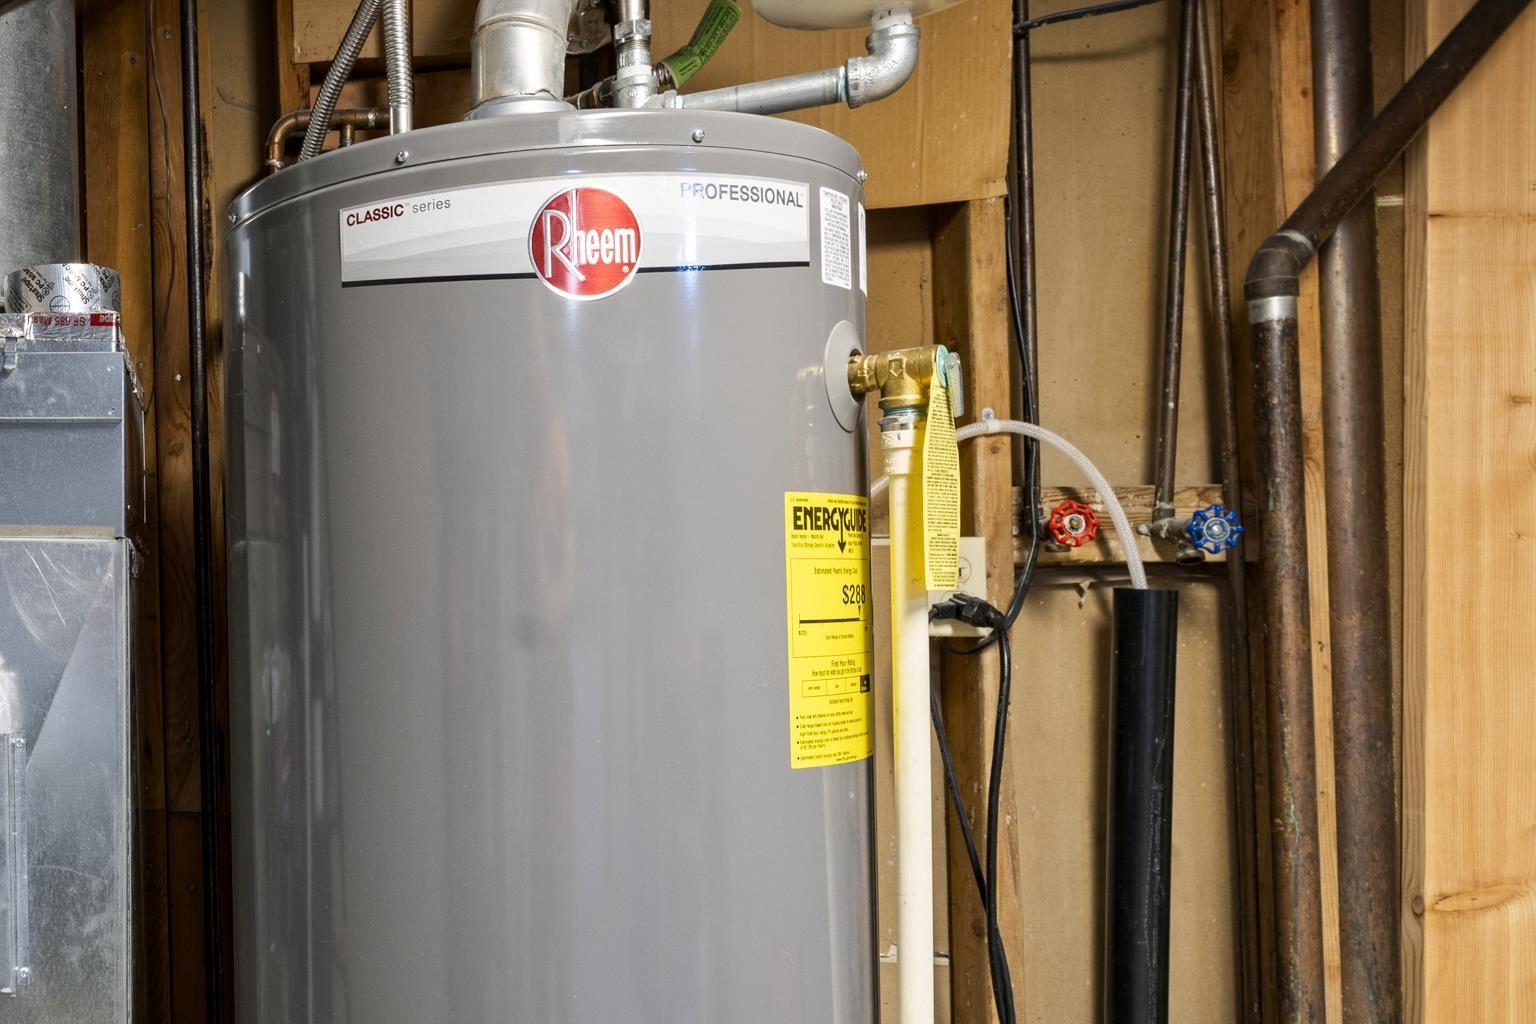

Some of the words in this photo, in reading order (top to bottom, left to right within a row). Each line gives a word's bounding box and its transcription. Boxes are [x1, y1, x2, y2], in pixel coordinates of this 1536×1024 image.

[680, 182, 803, 208] PROFESSIONAL
[346, 204, 404, 227] CLASSIC
[412, 198, 451, 214] series
[543, 189, 637, 282] Rheem
[55, 316, 71, 326] 685
[73, 317, 86, 326] SF
